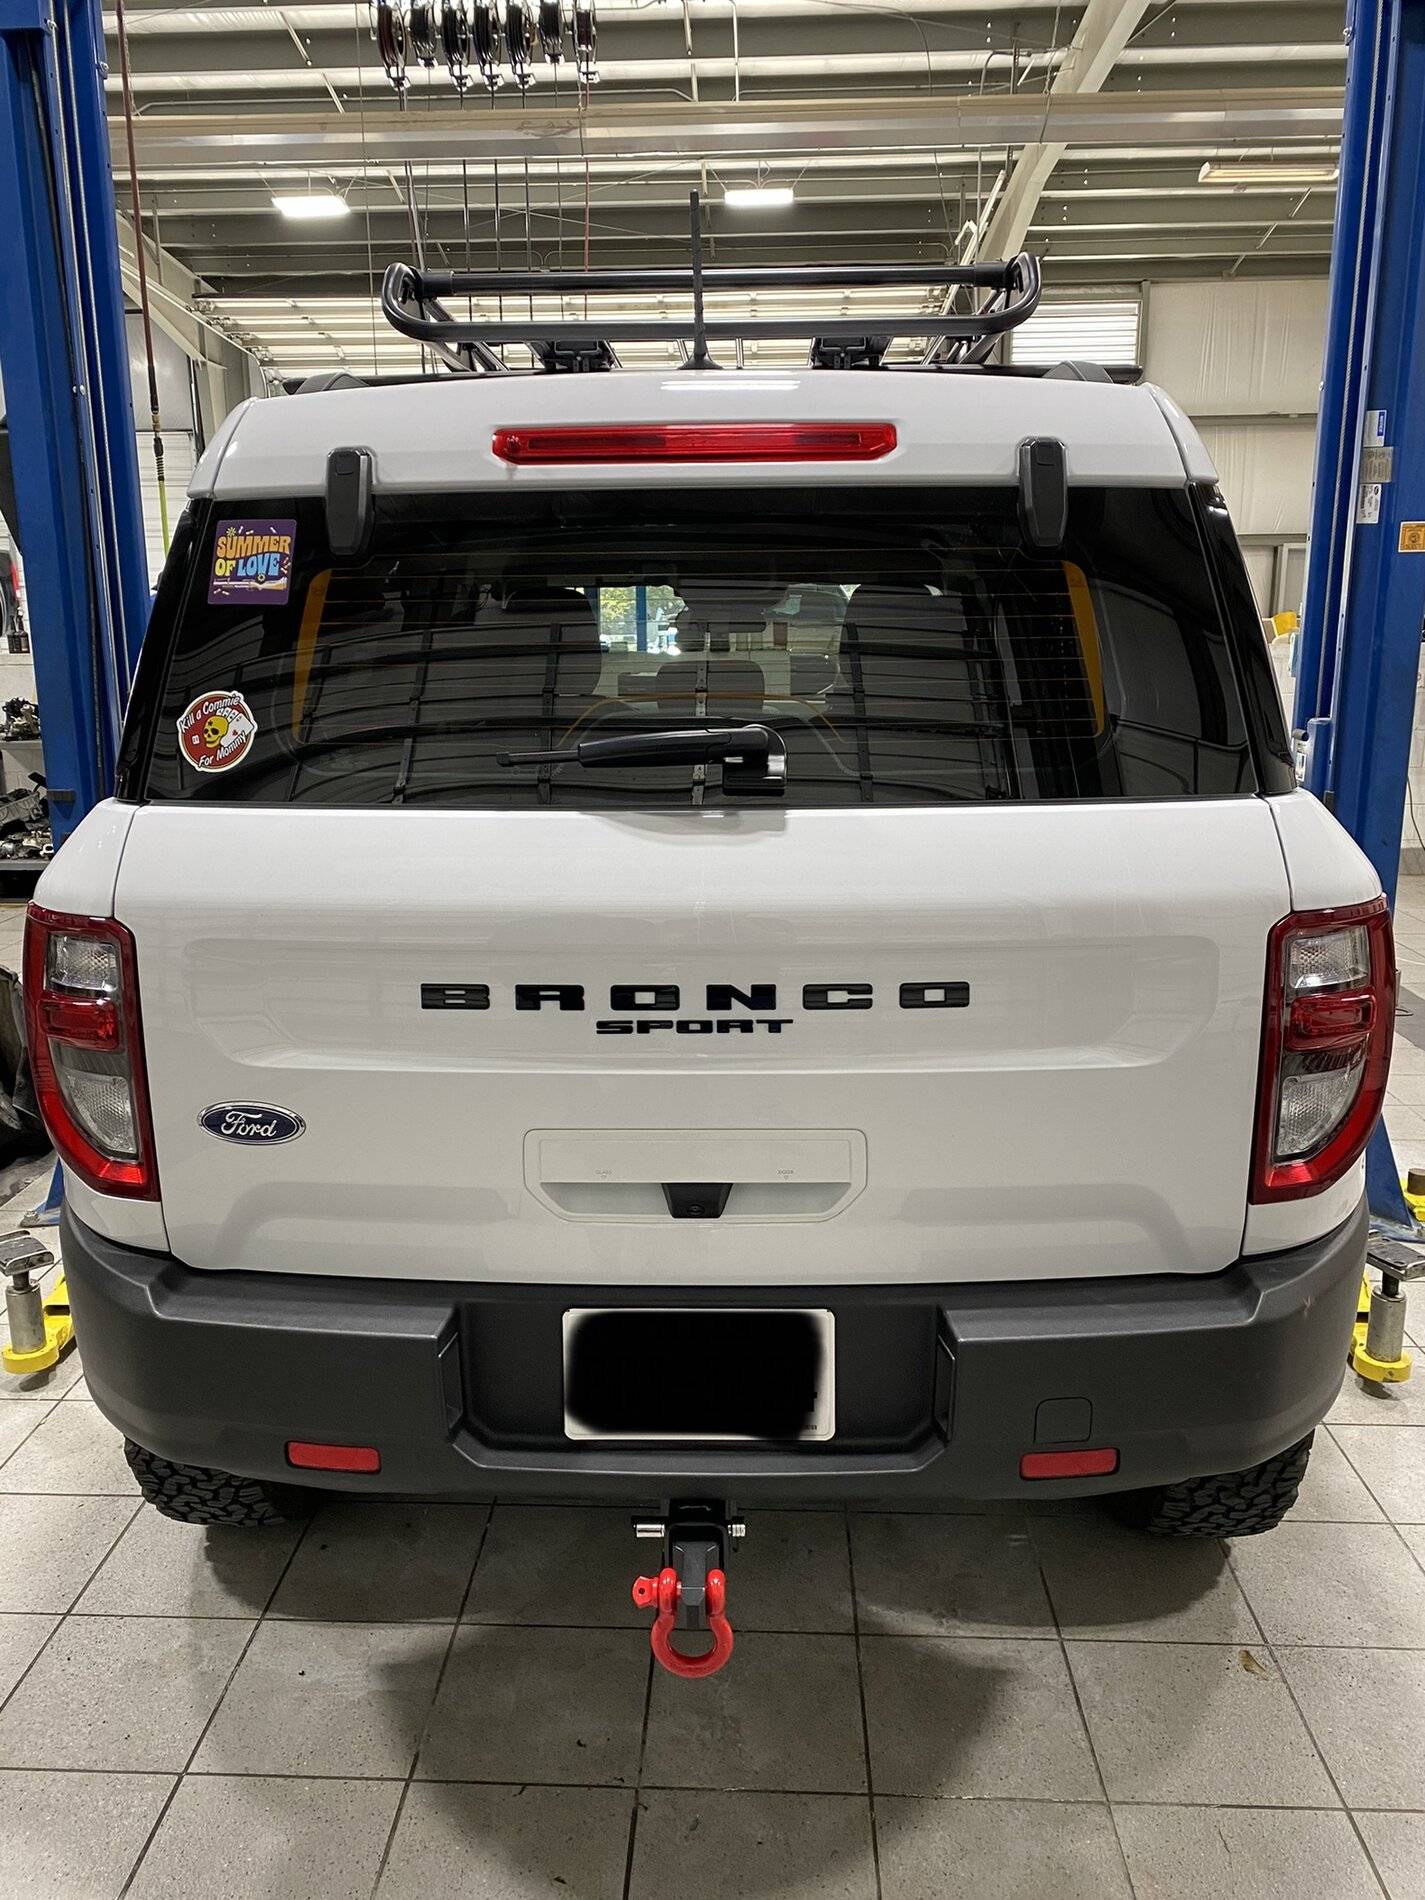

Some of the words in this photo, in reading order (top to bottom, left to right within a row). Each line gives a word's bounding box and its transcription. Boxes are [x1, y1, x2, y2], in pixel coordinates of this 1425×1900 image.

[216, 535, 291, 559] SUMMER
[214, 558, 236, 577] OF
[237, 553, 281, 577] LOVE
[180, 712, 196, 733] Kill
[196, 709, 202, 720] a
[203, 693, 240, 715] Commie
[198, 754, 214, 767] For
[216, 730, 247, 761] Mommy
[421, 982, 970, 1011] BRONCO
[596, 1019, 794, 1034] SPORT
[221, 1111, 277, 1137] Ford
